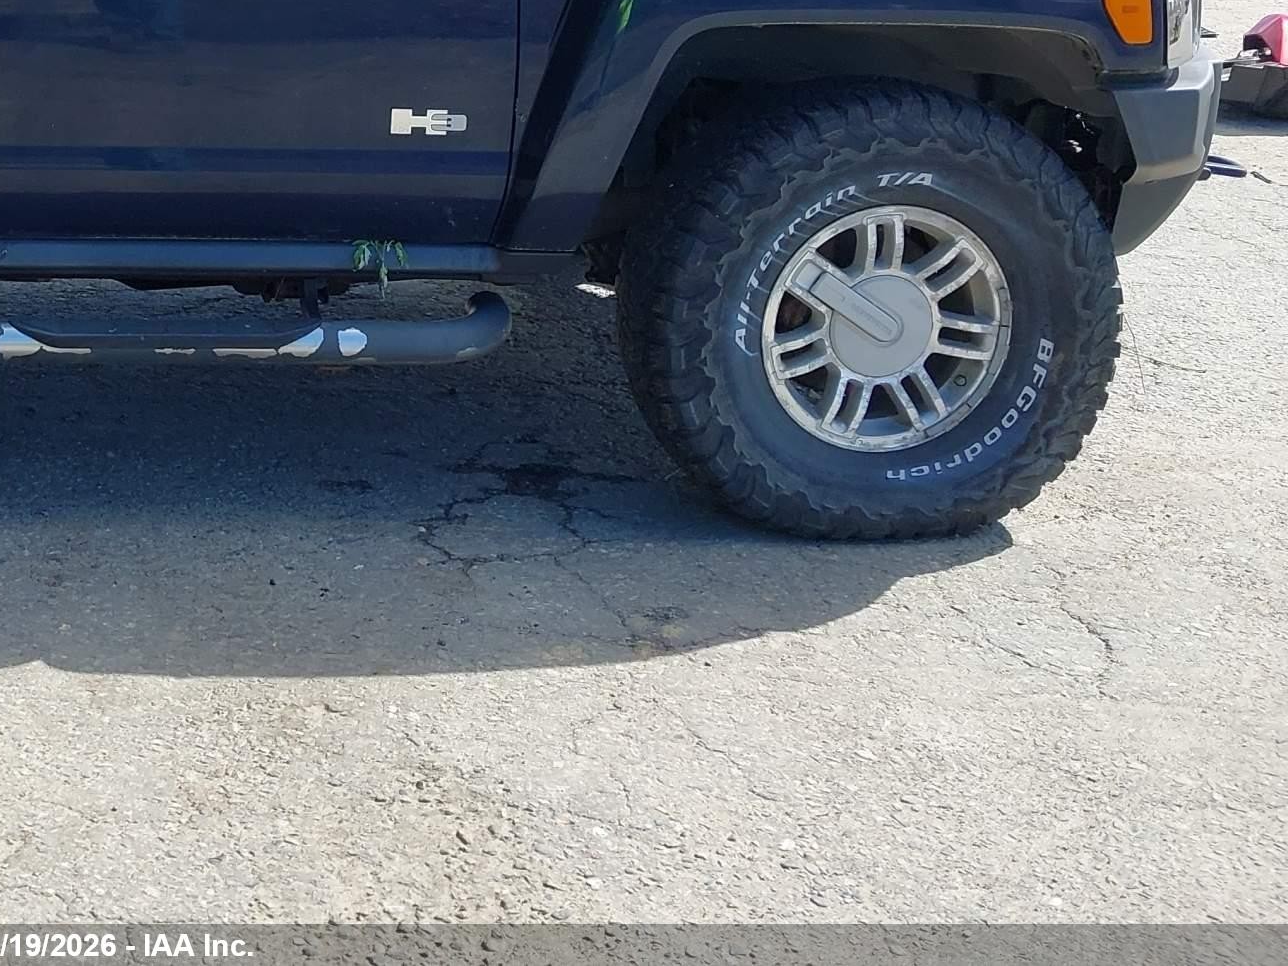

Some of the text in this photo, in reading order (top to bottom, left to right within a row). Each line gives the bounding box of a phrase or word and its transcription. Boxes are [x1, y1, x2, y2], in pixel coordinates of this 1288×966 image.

[734, 172, 933, 353] All-Terrain T/A
[886, 338, 1055, 481] BFGoodrich
